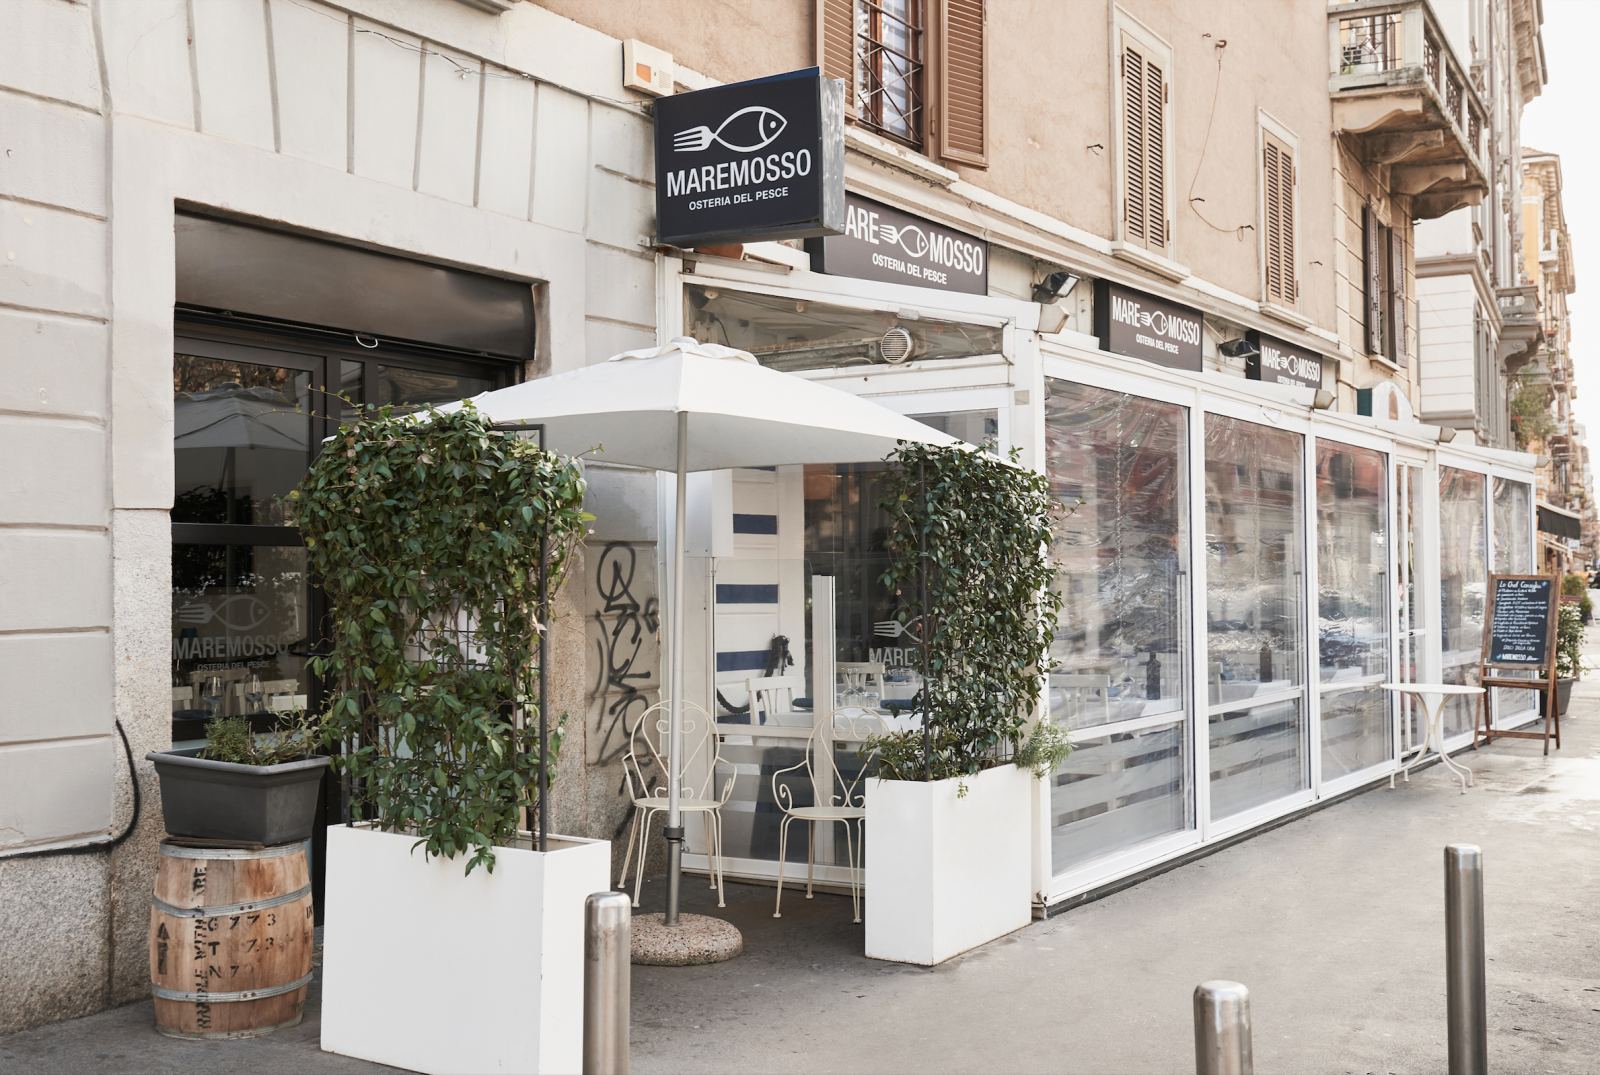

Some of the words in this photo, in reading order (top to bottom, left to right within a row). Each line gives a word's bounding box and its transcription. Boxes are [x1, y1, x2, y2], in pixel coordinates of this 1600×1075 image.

[666, 148, 812, 198] MAREMOSSO
[688, 195, 731, 211] OSTERIA
[733, 192, 753, 204] DEL
[755, 186, 789, 201] PESCE
[841, 204, 880, 246] ARE
[929, 231, 984, 276] MOSSO
[872, 252, 906, 273] OSTERIA
[907, 263, 922, 278] DEL
[923, 268, 948, 285] PESCE
[1112, 295, 1141, 328] MARE
[1168, 314, 1200, 346] MOSSO
[1135, 333, 1155, 348] OSTERIA
[1155, 339, 1165, 351] DEL
[1164, 342, 1180, 355] PESCE
[1261, 345, 1281, 371] MARE
[1298, 357, 1321, 382] MOSSO
[172, 634, 289, 660] MAREMOSSO
[868, 647, 916, 666] MARE
[197, 663, 229, 672] OSTERIA
[231, 661, 245, 670] DEL
